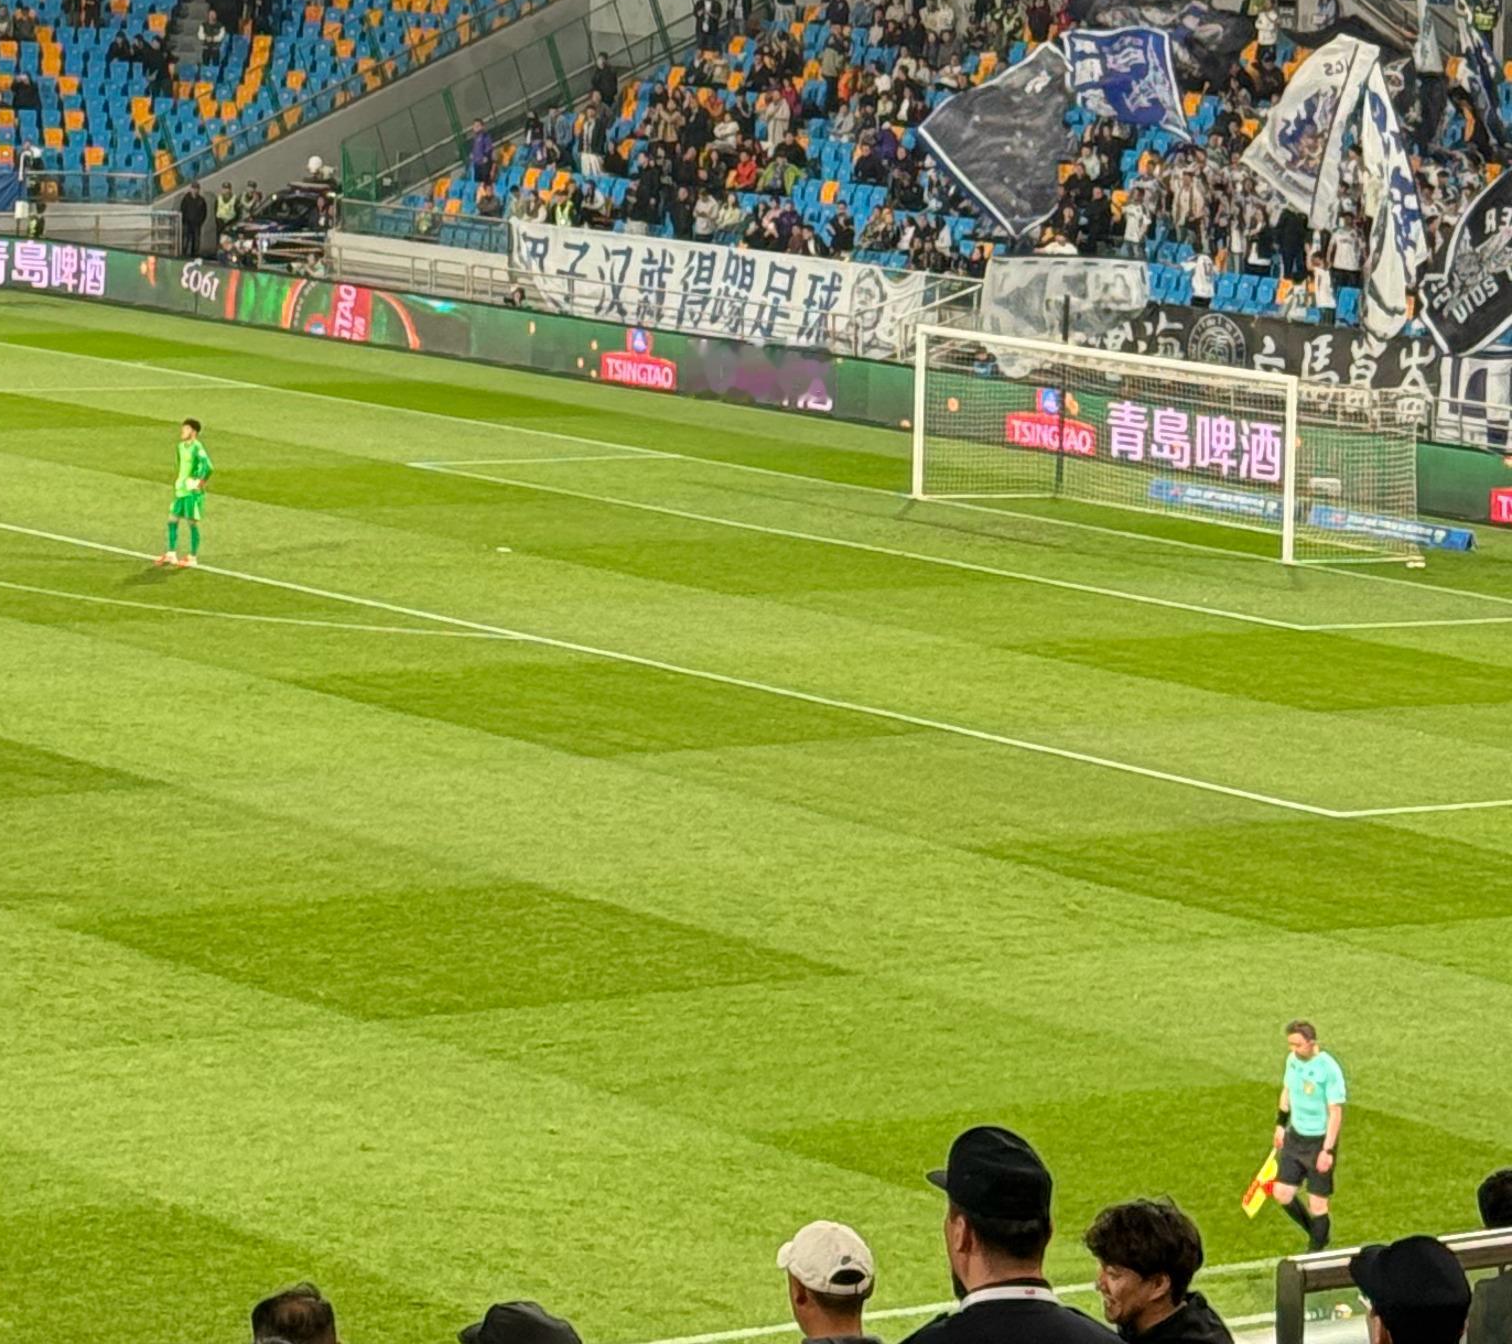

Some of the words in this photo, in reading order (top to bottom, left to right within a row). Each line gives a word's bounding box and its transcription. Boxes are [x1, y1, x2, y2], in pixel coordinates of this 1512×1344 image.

[605, 357, 674, 390] TSINGTAO
[1107, 400, 1284, 483] 青島啤酒
